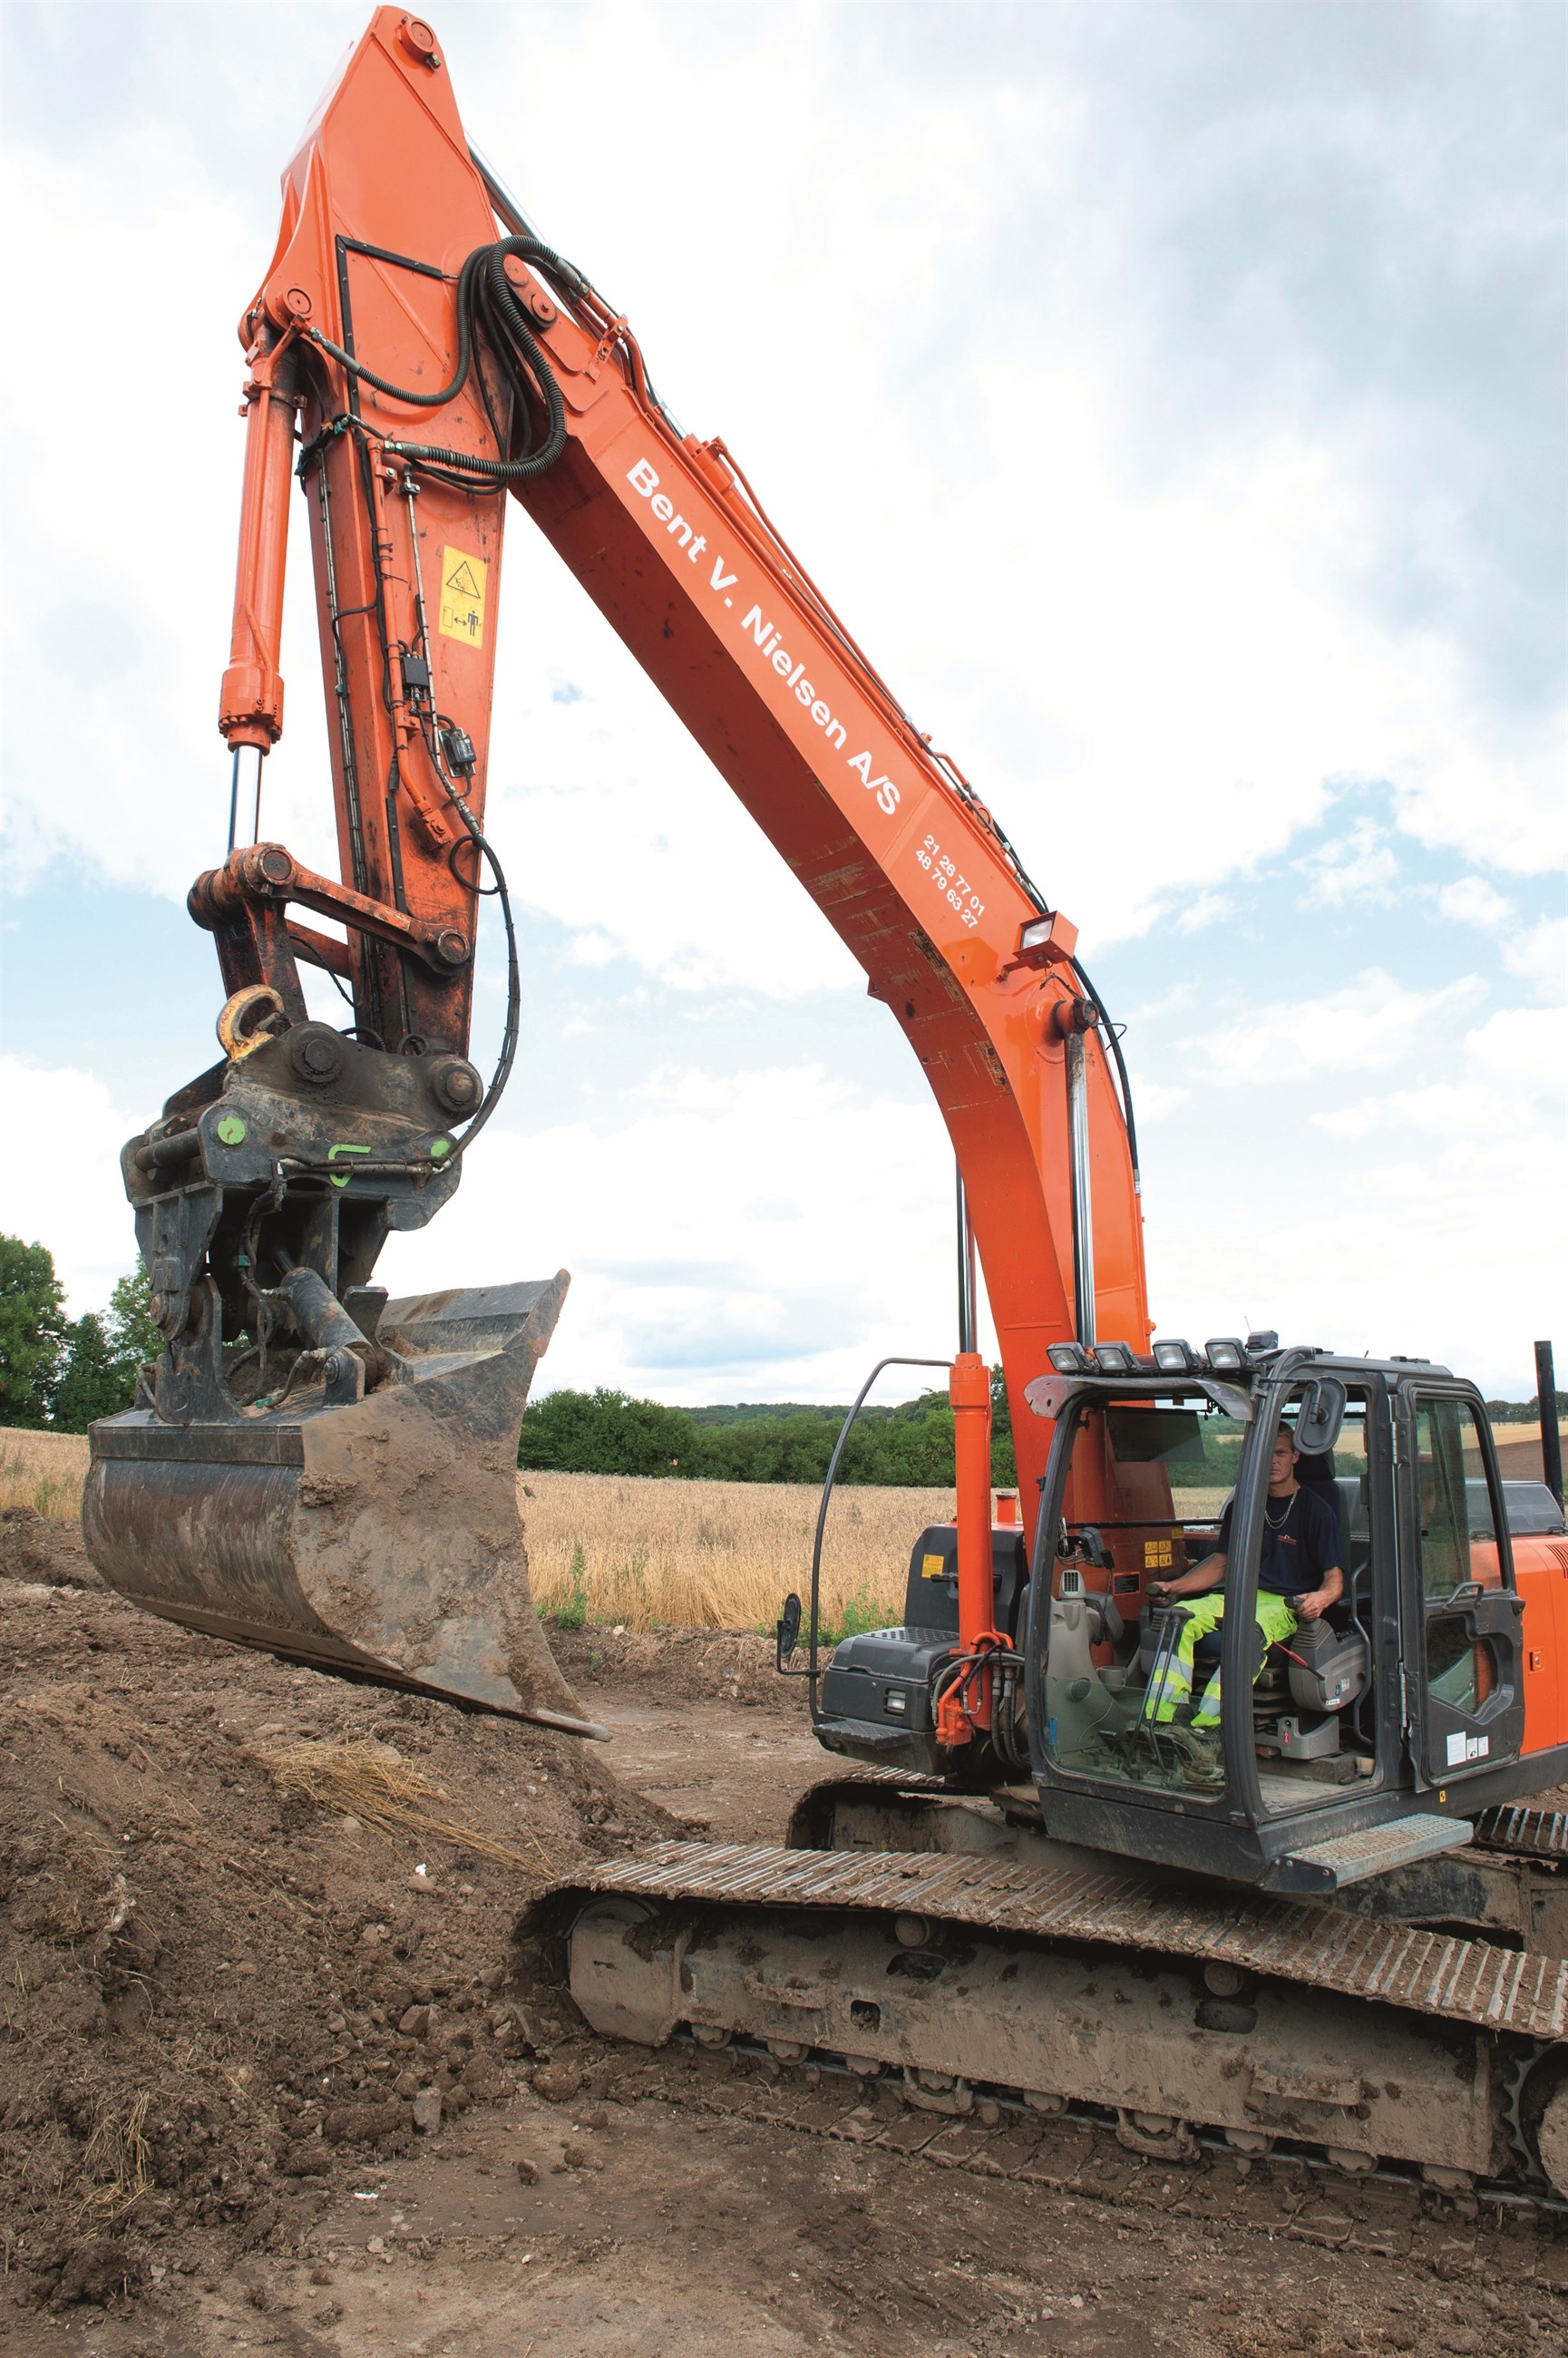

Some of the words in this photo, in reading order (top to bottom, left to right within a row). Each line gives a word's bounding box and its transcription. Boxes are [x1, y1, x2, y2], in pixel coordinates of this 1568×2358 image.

[626, 457, 707, 563] Bent
[709, 555, 738, 608] V.
[740, 604, 847, 750] Nielsen
[846, 750, 901, 815] A/S
[915, 849, 932, 871] 48
[930, 867, 948, 891] 79
[946, 889, 963, 911] 63
[960, 909, 979, 929] 27
[923, 834, 940, 856] 21
[939, 855, 956, 877] 26
[955, 874, 972, 895] 77
[969, 895, 985, 917] 01
